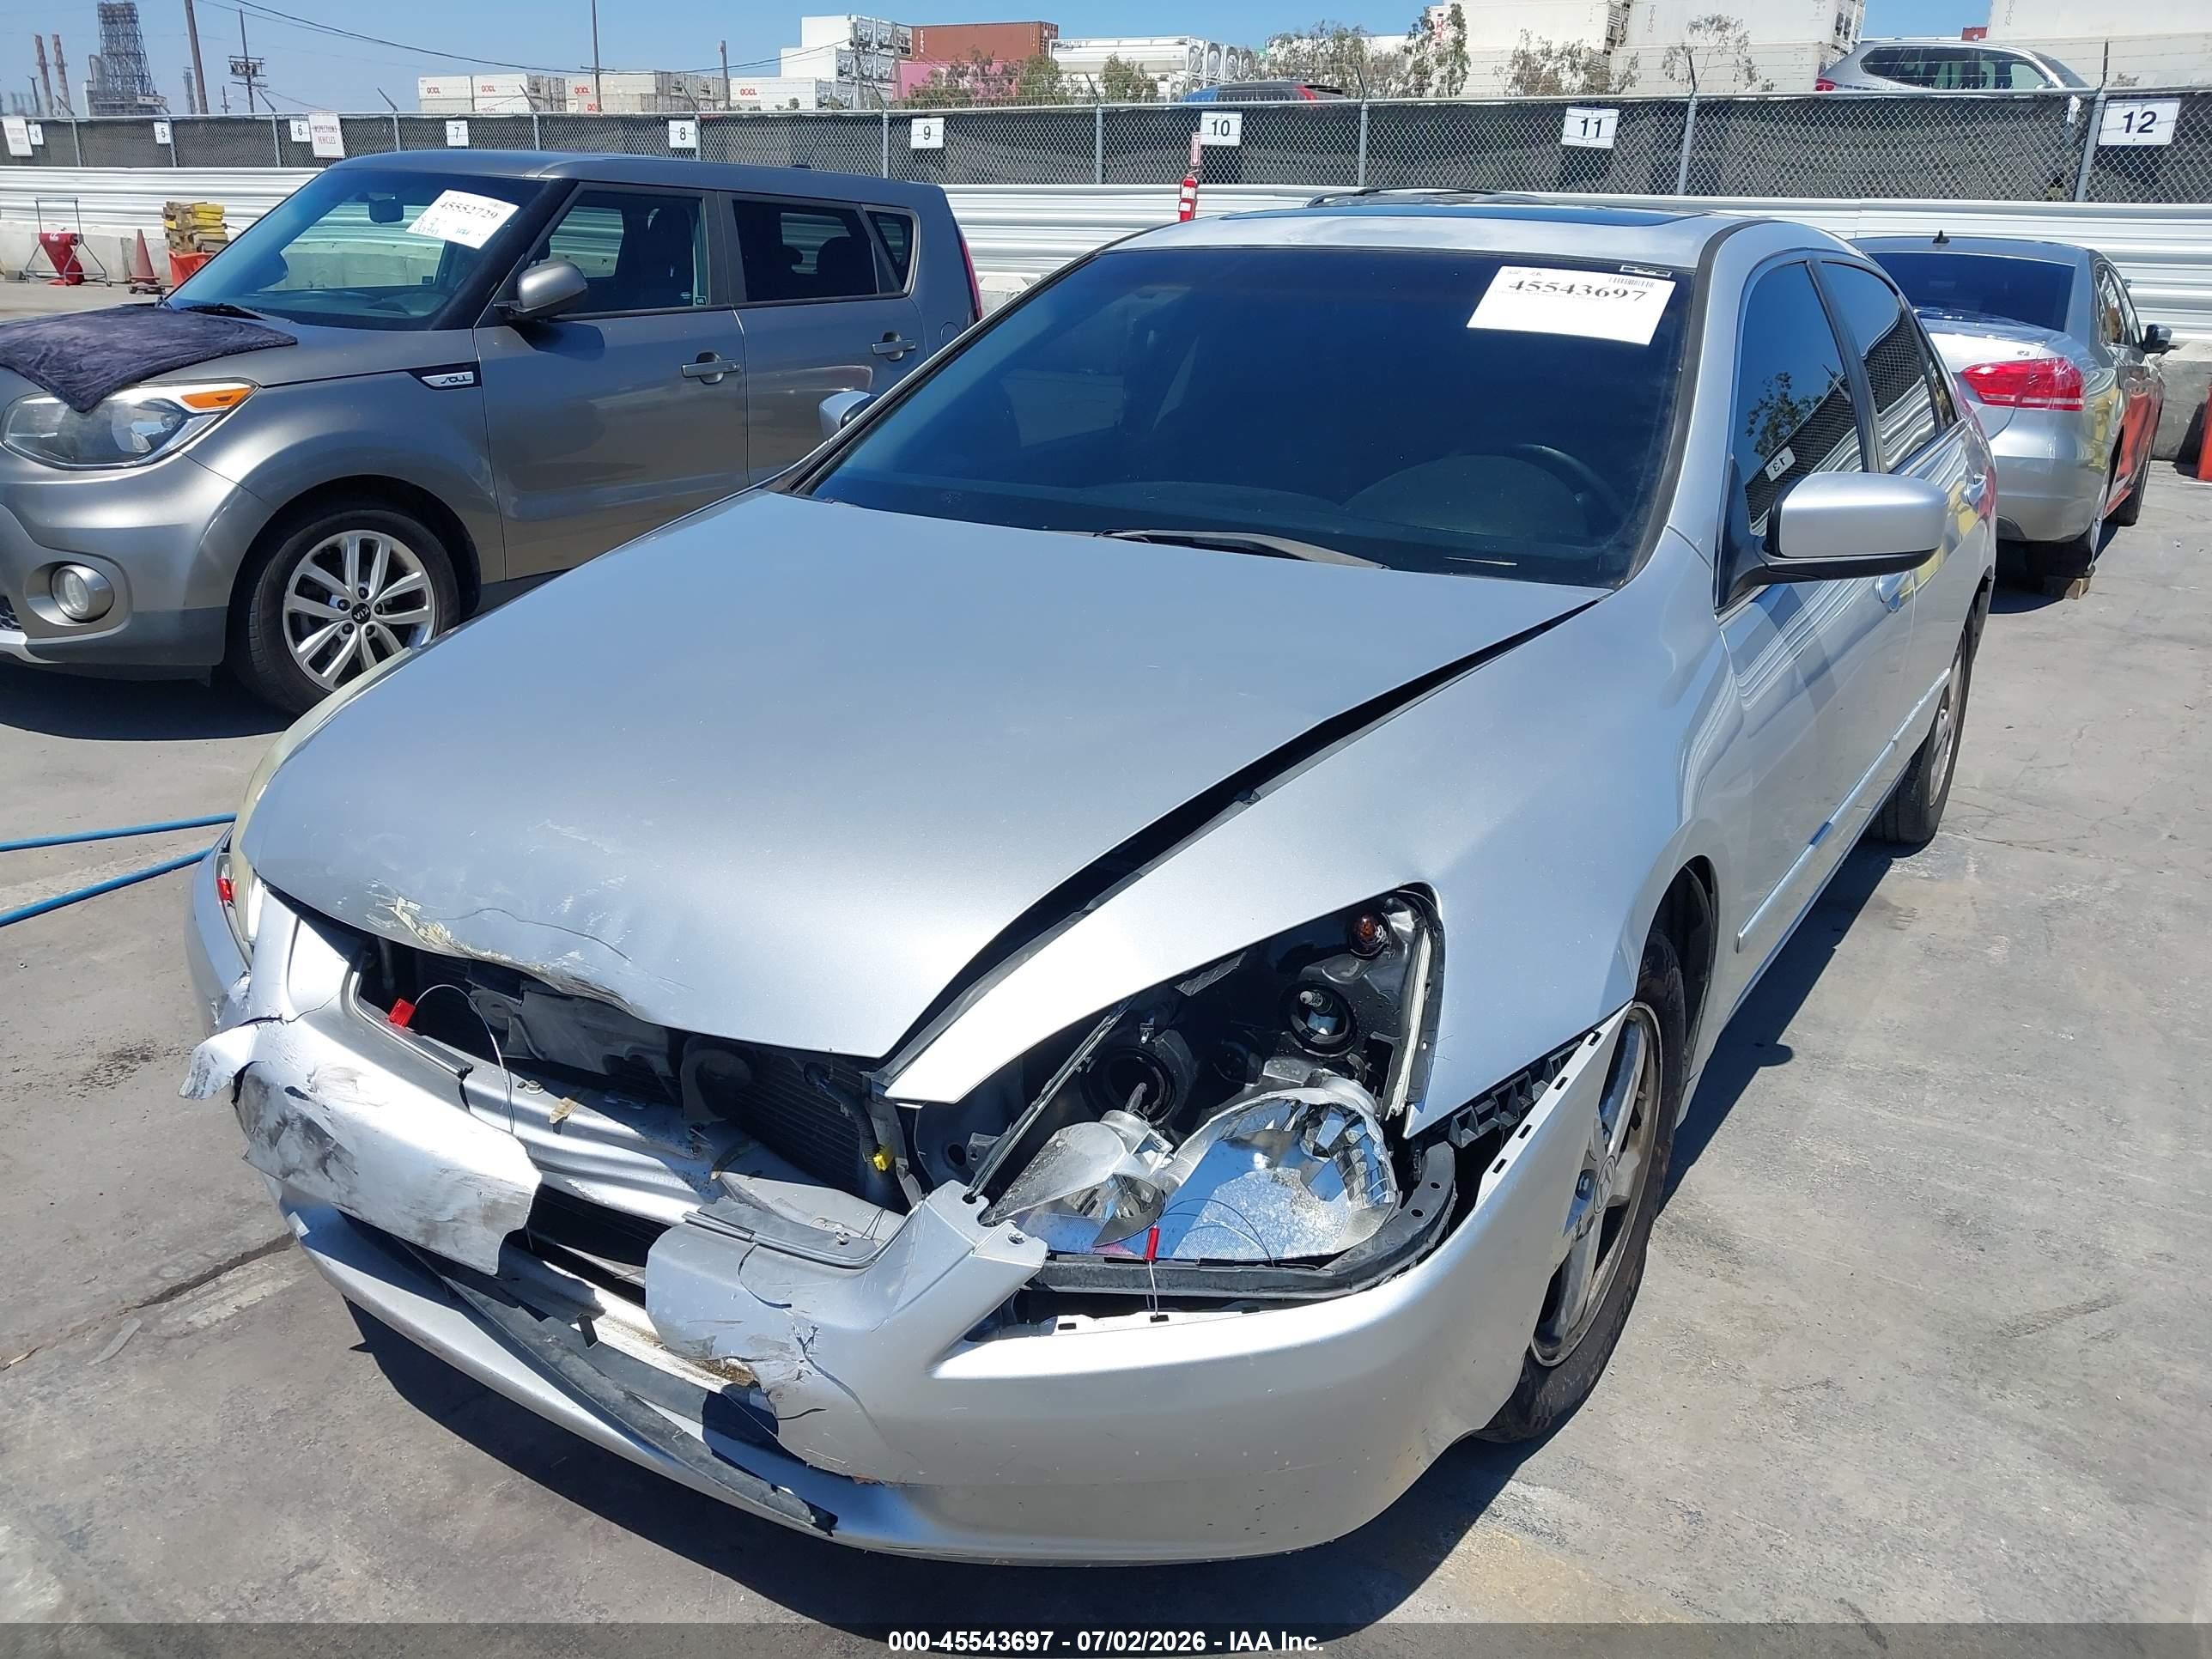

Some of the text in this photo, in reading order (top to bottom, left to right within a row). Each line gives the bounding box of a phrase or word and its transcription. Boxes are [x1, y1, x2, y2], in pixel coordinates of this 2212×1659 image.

[297, 124, 303, 137] 6
[1212, 119, 1231, 137] 10
[1581, 117, 1602, 138] 11
[2123, 110, 2158, 134] 12
[161, 126, 167, 138] 5
[454, 126, 460, 139] 7
[679, 126, 686, 141] 8
[923, 125, 932, 141] 9
[439, 200, 499, 220] 45552729
[1508, 279, 1649, 301] 45543697
